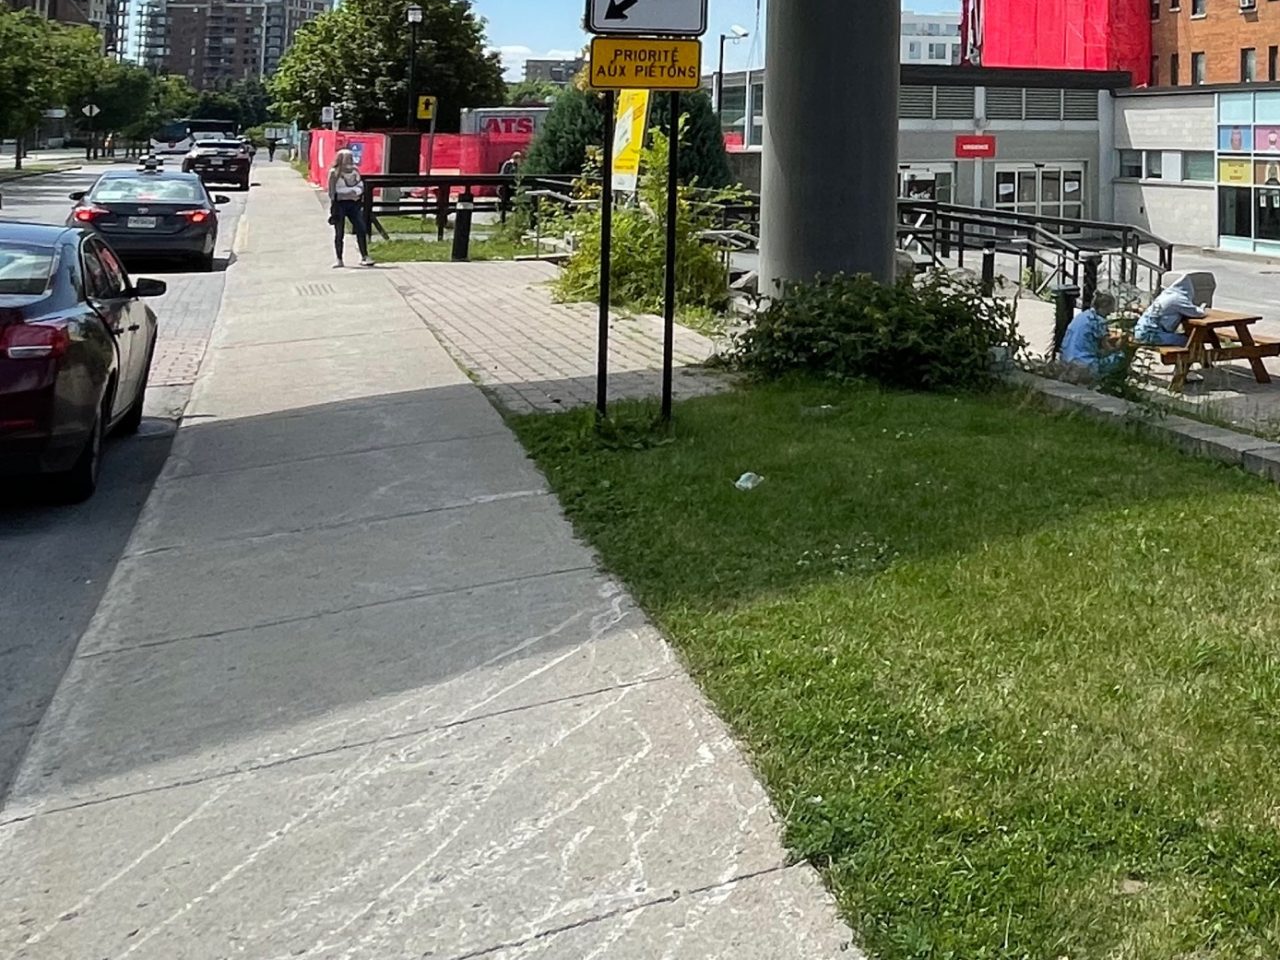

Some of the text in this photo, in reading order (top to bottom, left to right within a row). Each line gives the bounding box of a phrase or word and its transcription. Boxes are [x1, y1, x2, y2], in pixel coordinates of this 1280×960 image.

[614, 47, 679, 63] PRIORITÉ
[597, 62, 696, 78] AUX PIÉTONS
[484, 117, 533, 134] ATS
